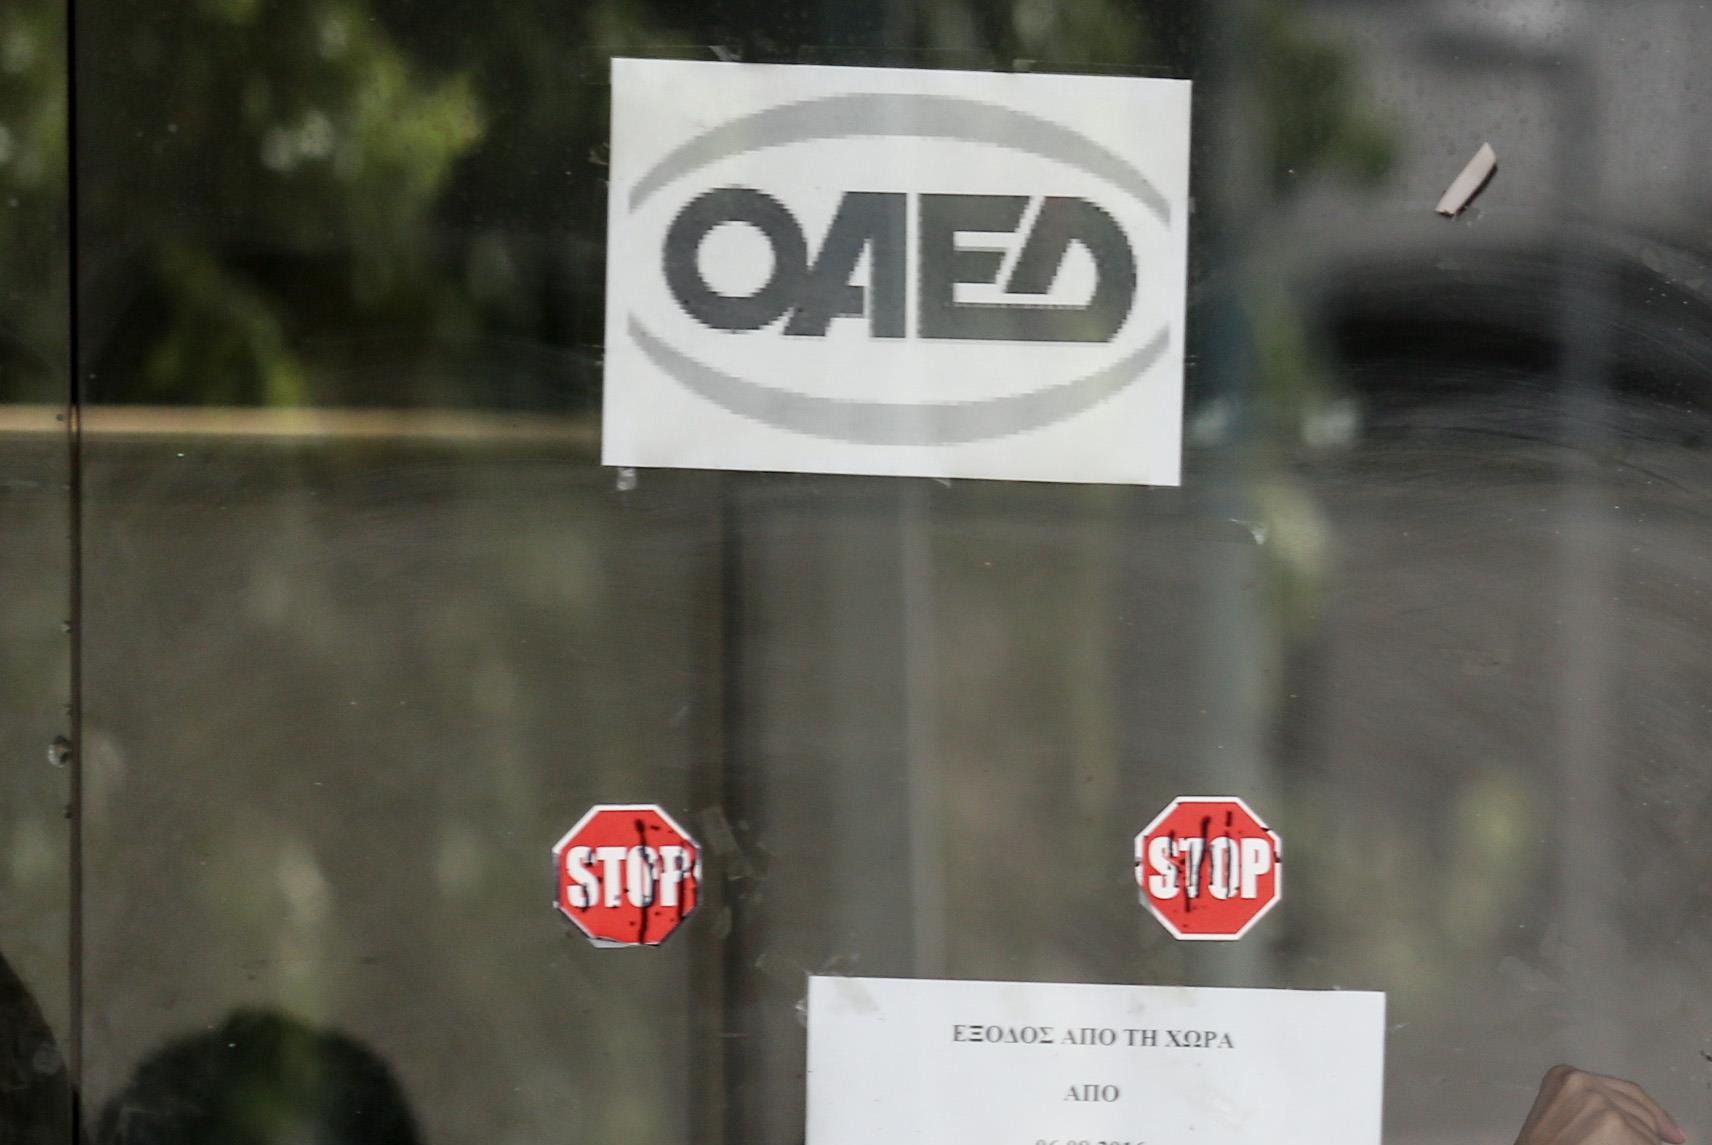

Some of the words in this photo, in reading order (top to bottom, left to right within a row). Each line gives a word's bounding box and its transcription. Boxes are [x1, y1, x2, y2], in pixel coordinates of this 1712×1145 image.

[566, 845, 691, 908] STOP
[1148, 836, 1272, 900] STOP
[954, 1025, 1053, 1044] ΕΞΟΔΟΣ
[1063, 1028, 1117, 1046] ΑΠΟ
[1125, 1029, 1157, 1046] ΤΗ
[1166, 1030, 1233, 1048] ΧΩΡΑ
[1065, 1085, 1120, 1102] ΑΠΟ
